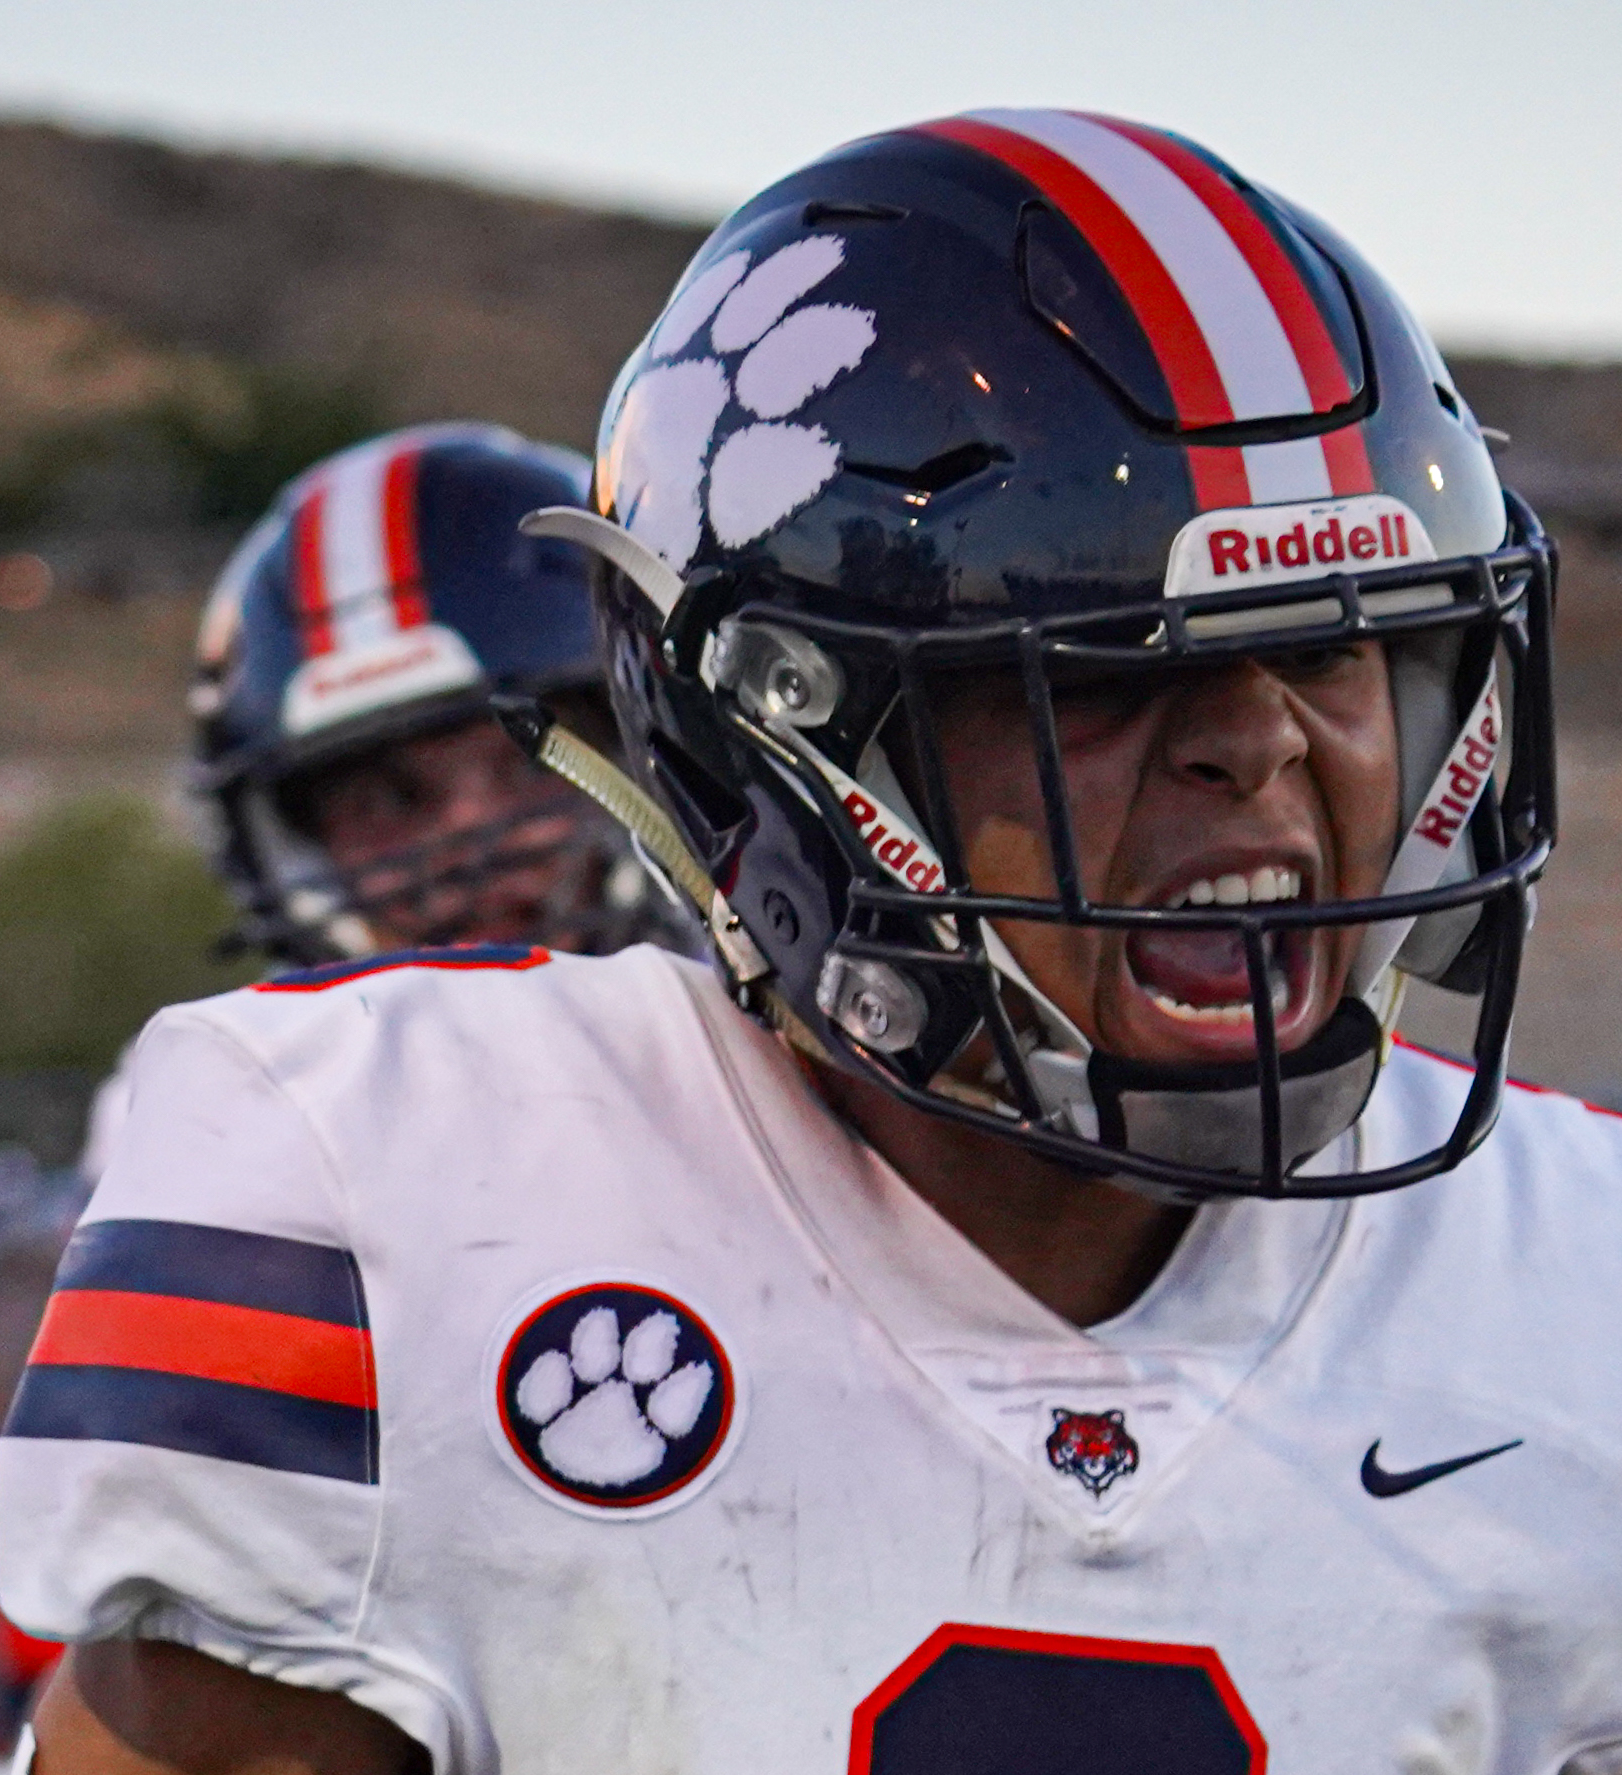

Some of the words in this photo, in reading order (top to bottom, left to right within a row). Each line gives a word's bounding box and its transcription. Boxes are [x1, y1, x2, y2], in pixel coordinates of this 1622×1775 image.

[1206, 513, 1410, 577] Riddell
[1414, 694, 1498, 849] Ridde
[843, 791, 944, 892] Ridd
